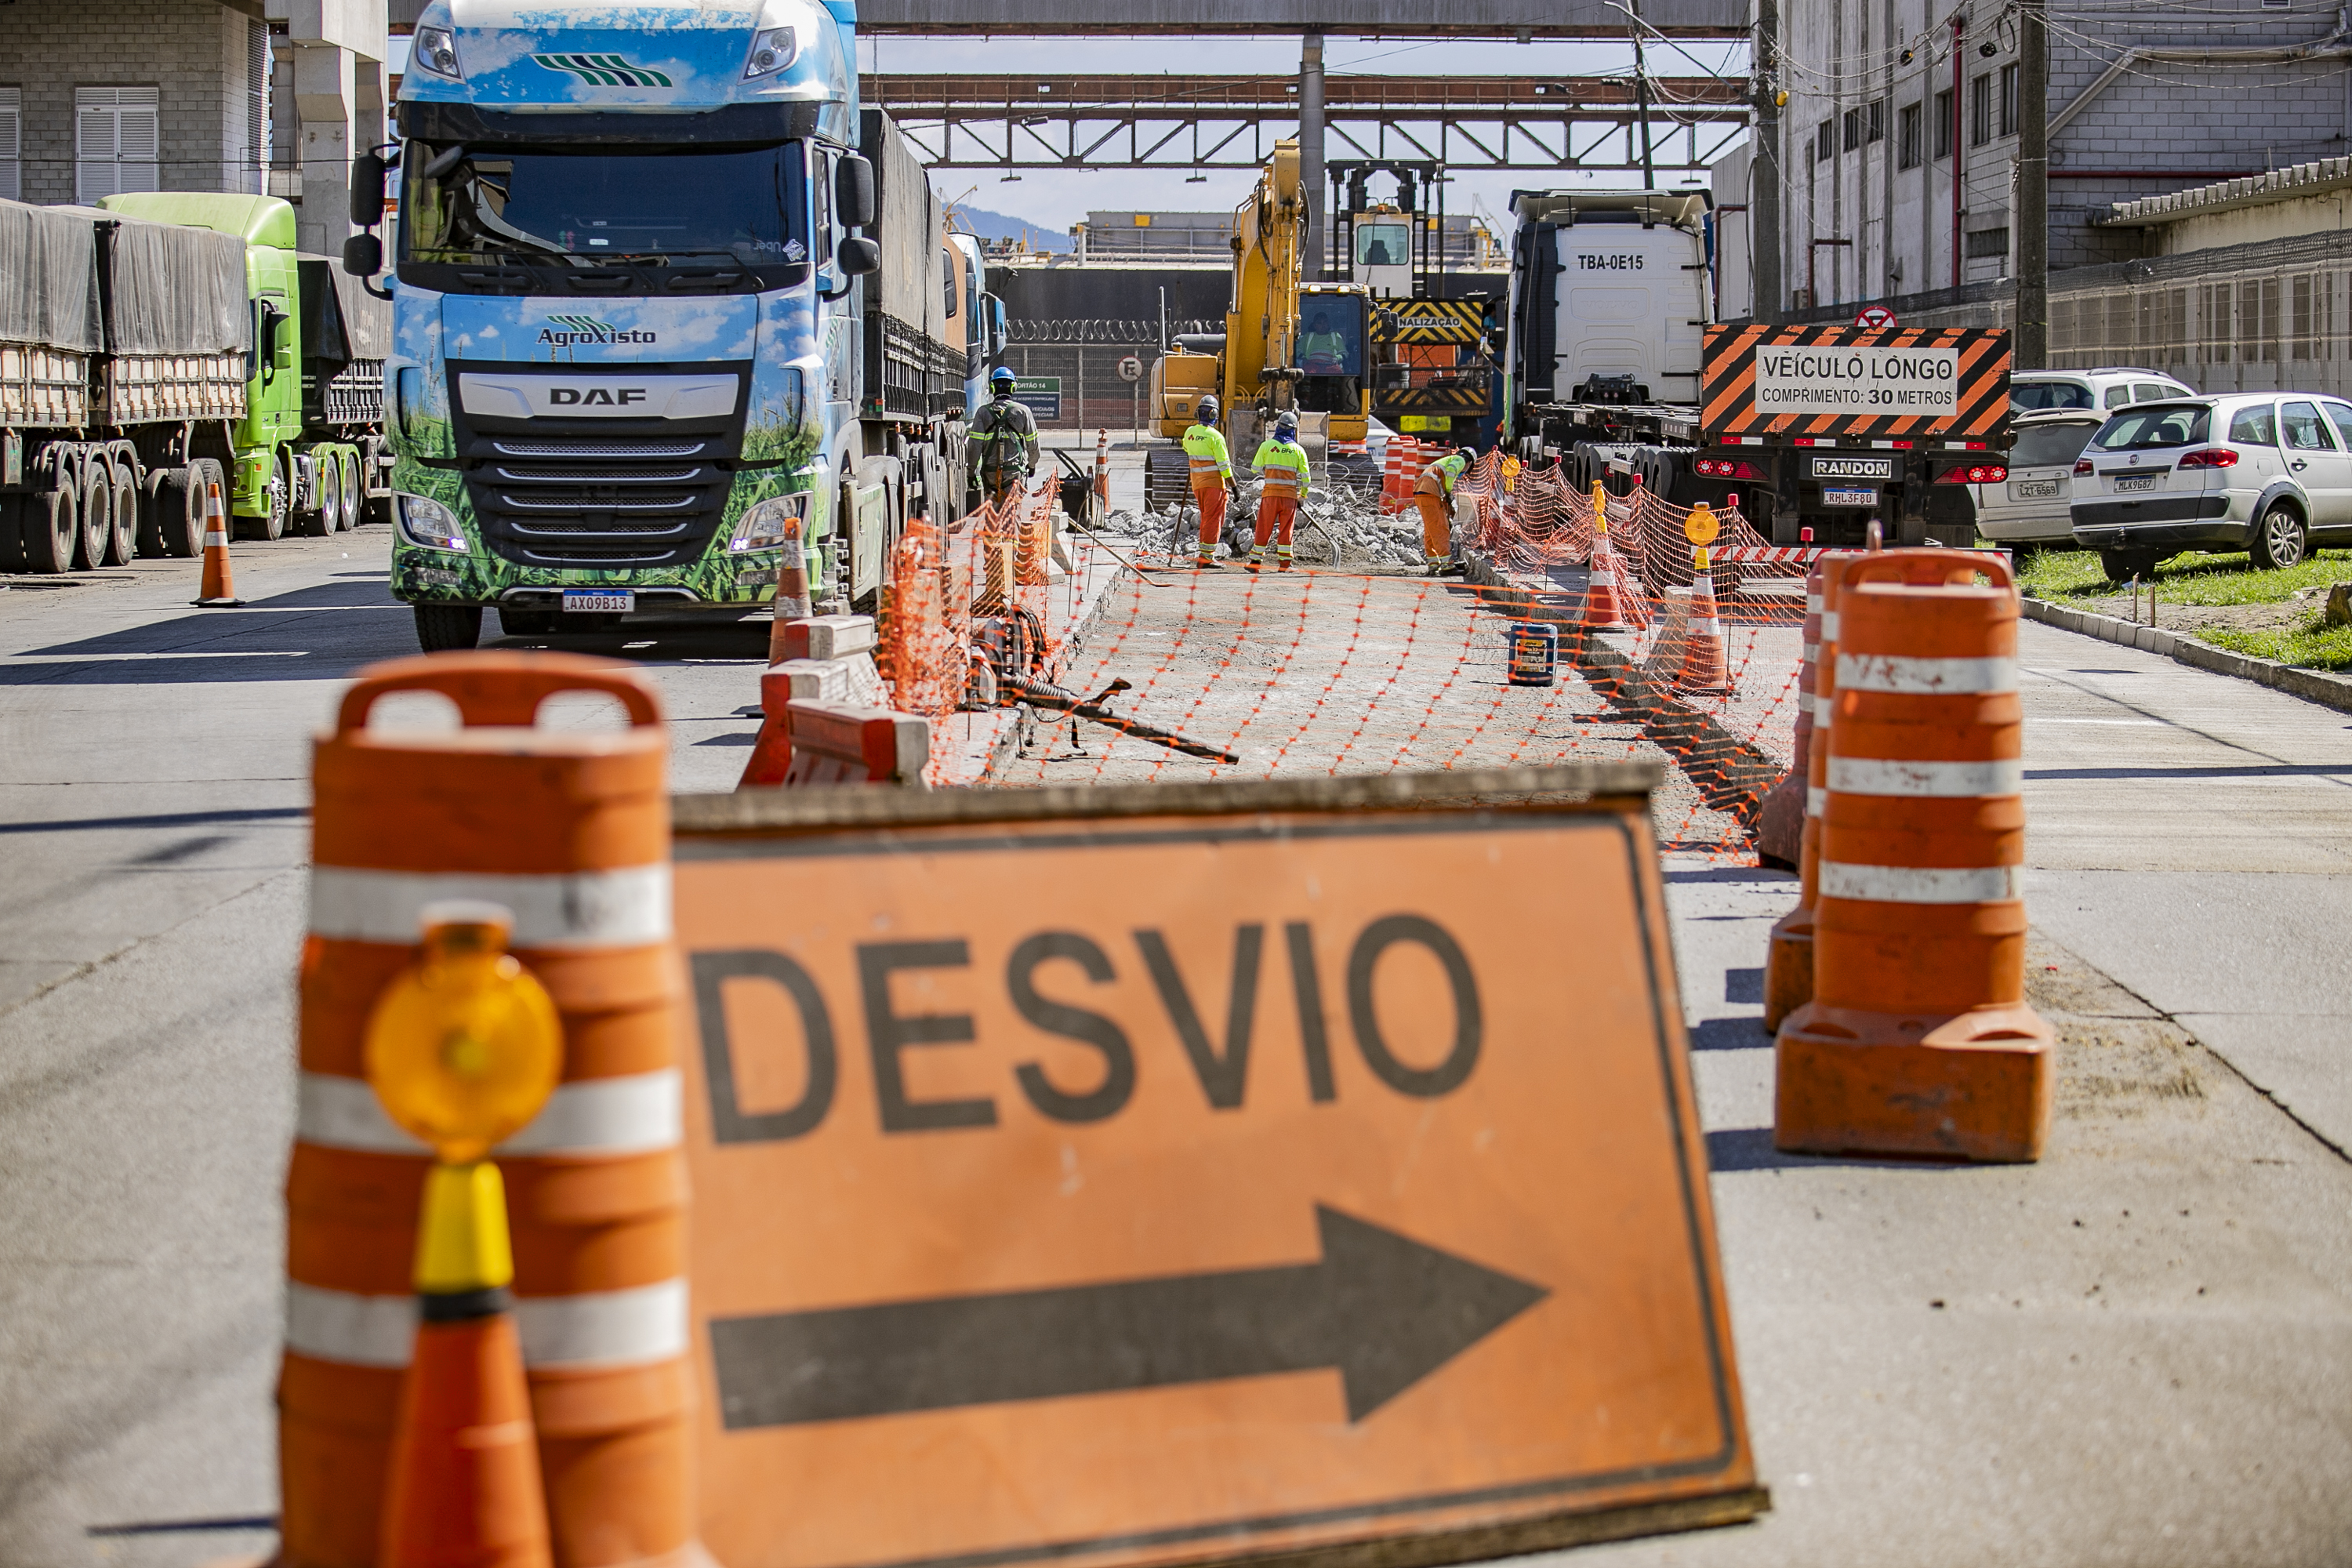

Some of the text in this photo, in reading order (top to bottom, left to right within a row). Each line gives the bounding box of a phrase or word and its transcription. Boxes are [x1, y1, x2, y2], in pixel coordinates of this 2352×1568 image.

[1399, 318, 1460, 327] NALIZAÇÃO
[1871, 358, 1953, 379] LONGO
[550, 388, 646, 405] DAF
[1762, 388, 1952, 405] COMPRIMENTO: 30 METROS
[1816, 461, 1888, 475] RANDON
[690, 911, 1485, 1146] DESVIO
